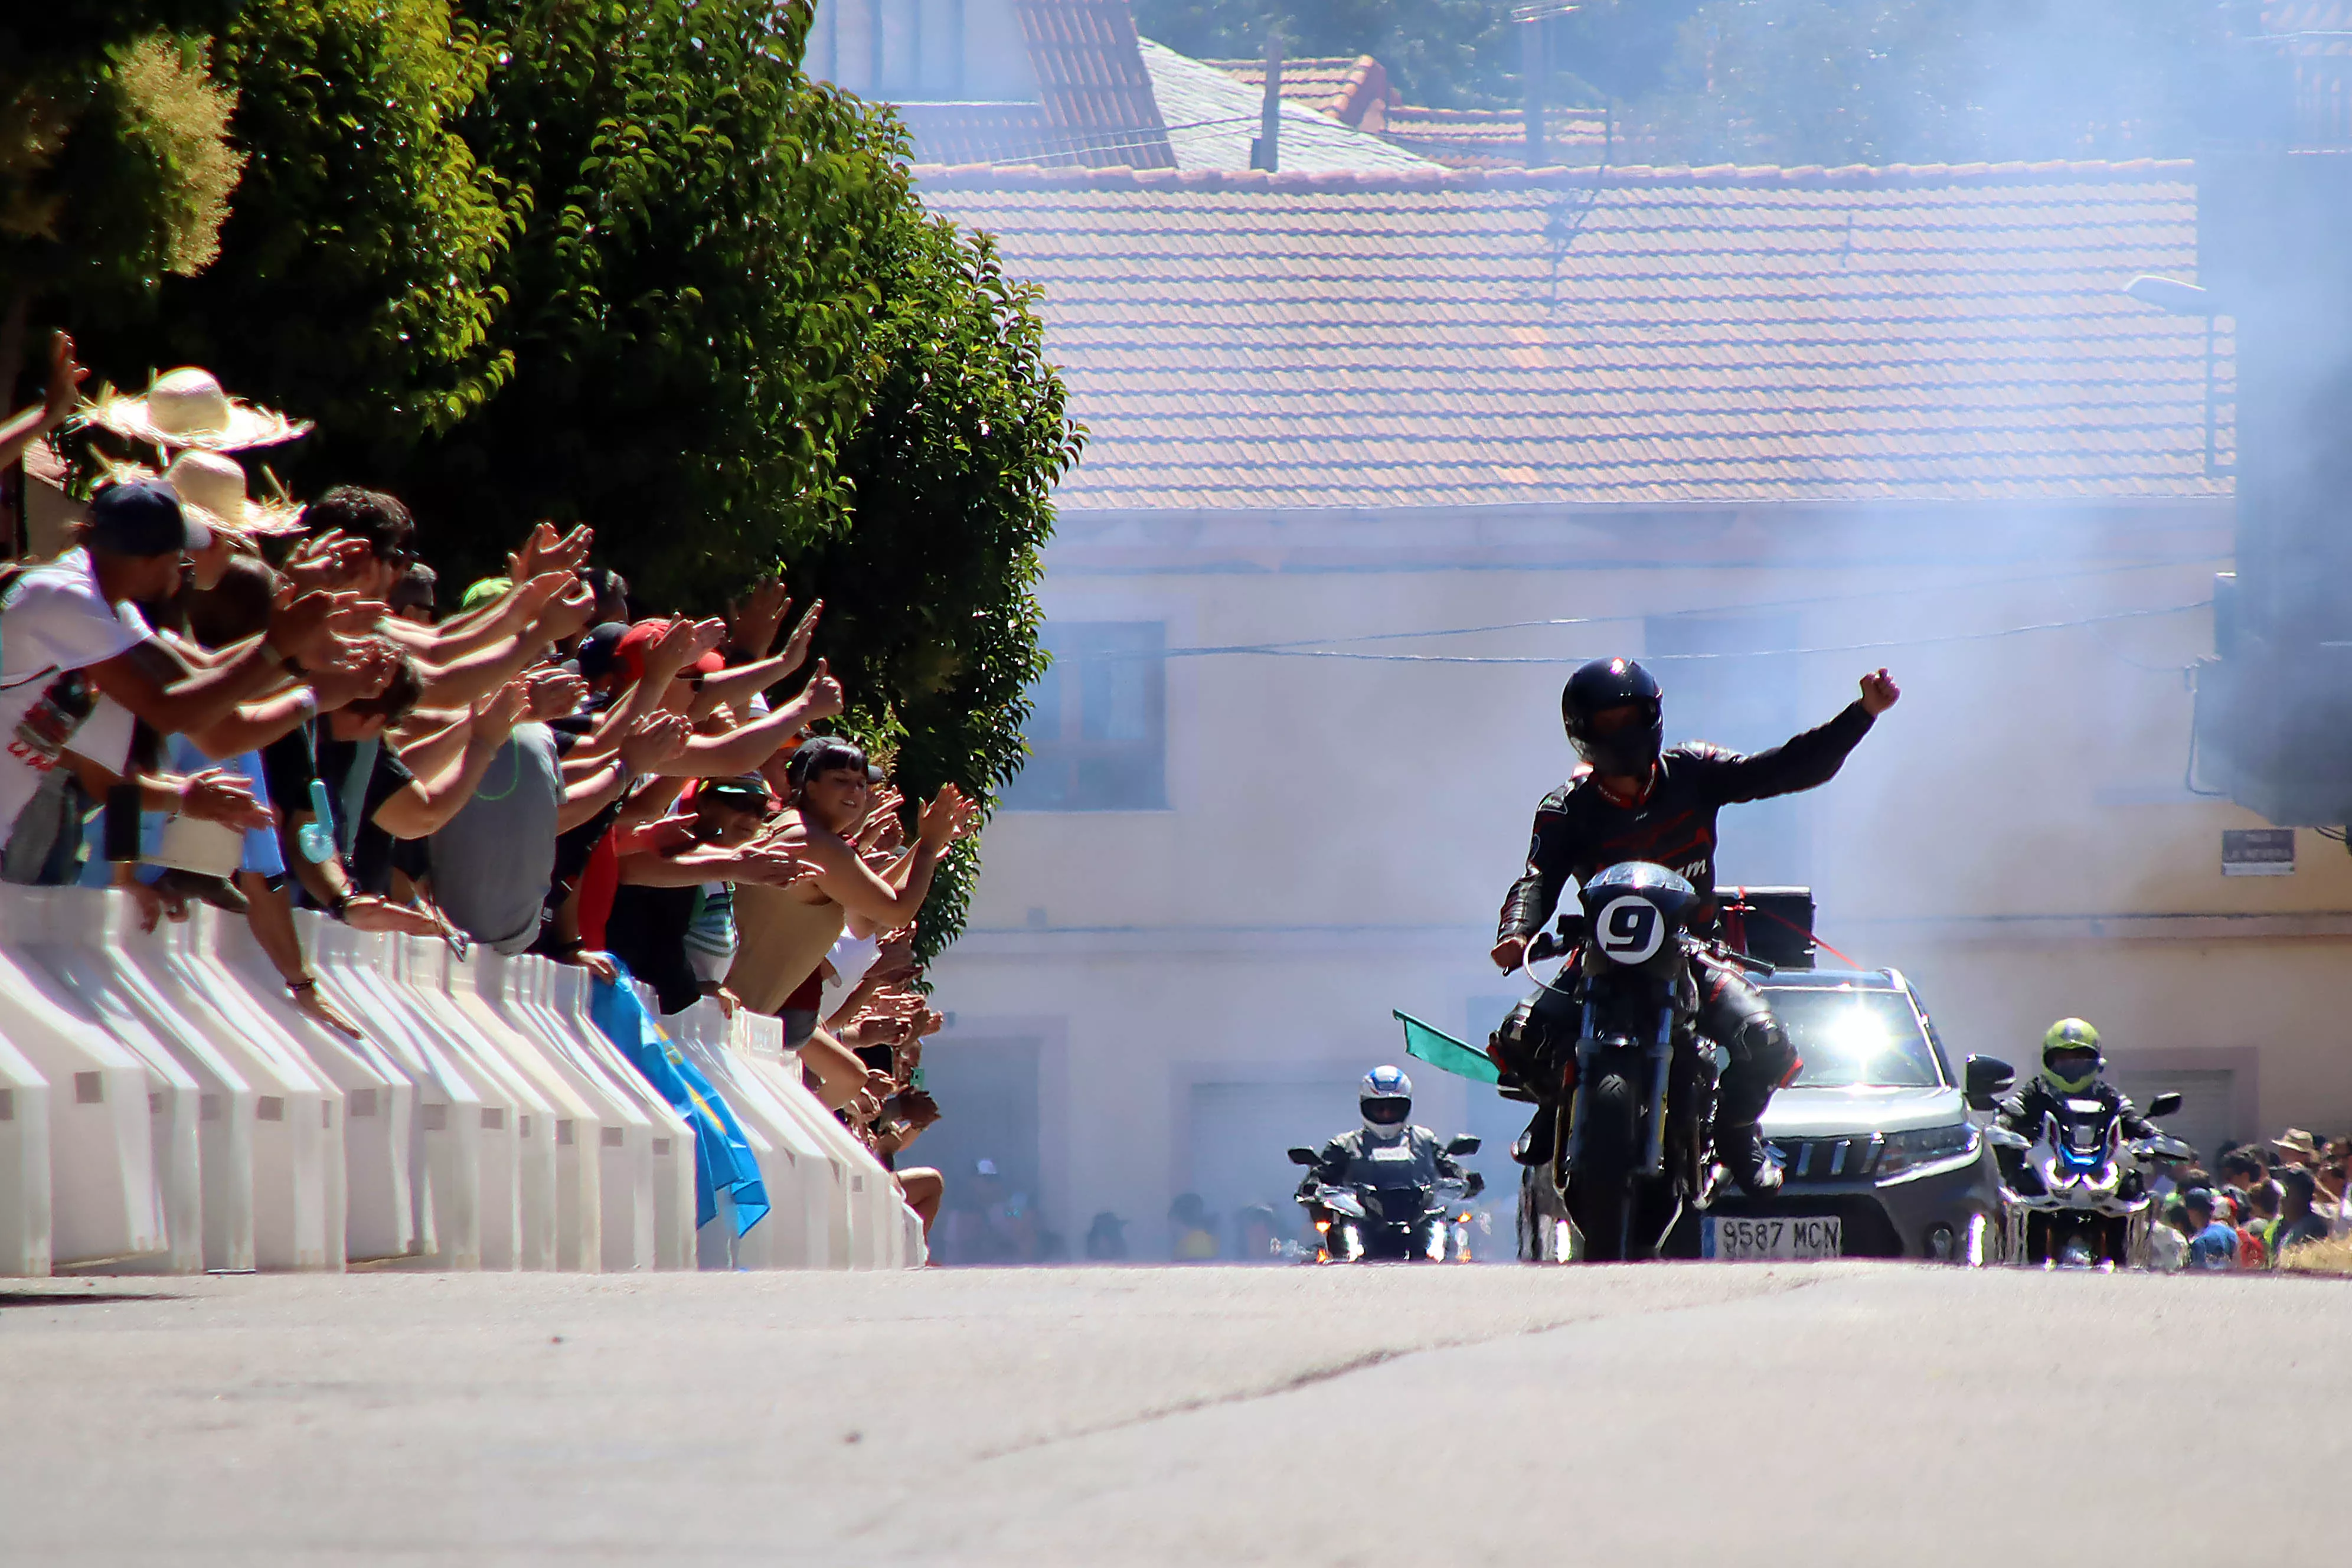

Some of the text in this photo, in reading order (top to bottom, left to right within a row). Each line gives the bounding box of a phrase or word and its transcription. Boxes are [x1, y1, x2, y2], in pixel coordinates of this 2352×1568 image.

[1606, 905, 1657, 952] 9
[1723, 1220, 1839, 1252] 9587 MCN
